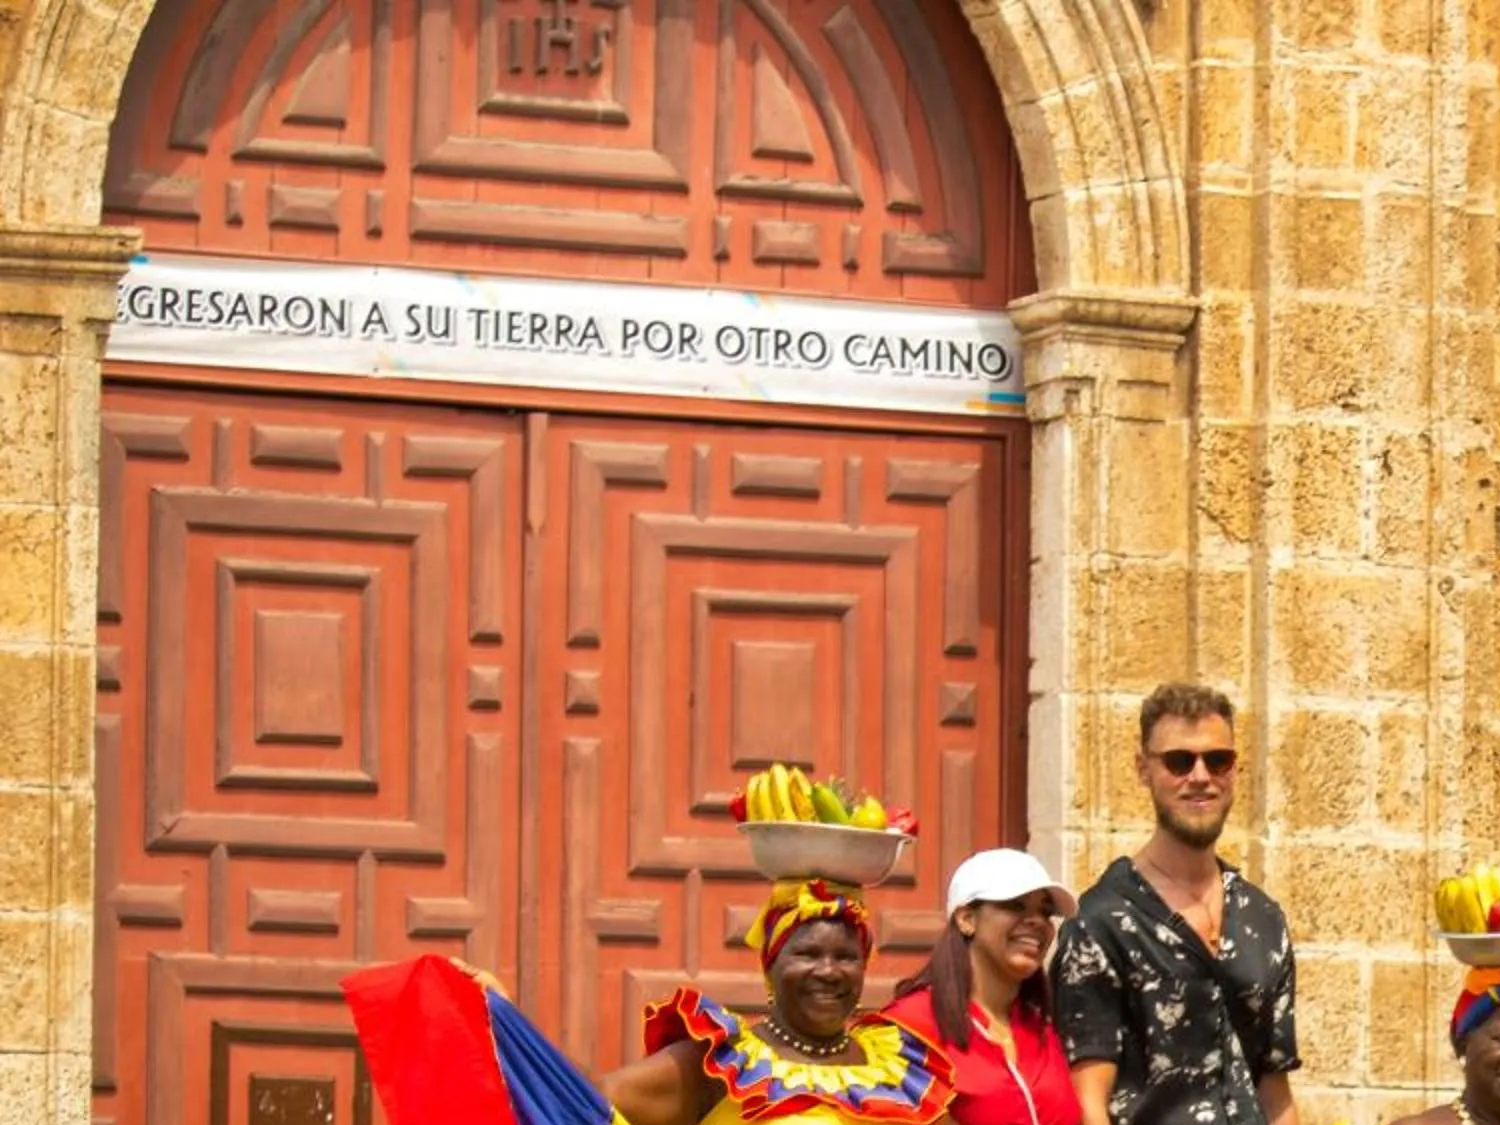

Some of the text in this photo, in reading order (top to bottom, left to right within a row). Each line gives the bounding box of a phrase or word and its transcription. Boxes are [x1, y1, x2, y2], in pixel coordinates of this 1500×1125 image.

[361, 301, 389, 335] A
[406, 303, 451, 339] SU
[467, 307, 604, 351] TIERRA
[621, 318, 699, 356] POR
[715, 325, 828, 364] OTRO
[843, 334, 1008, 377] CAMINO
